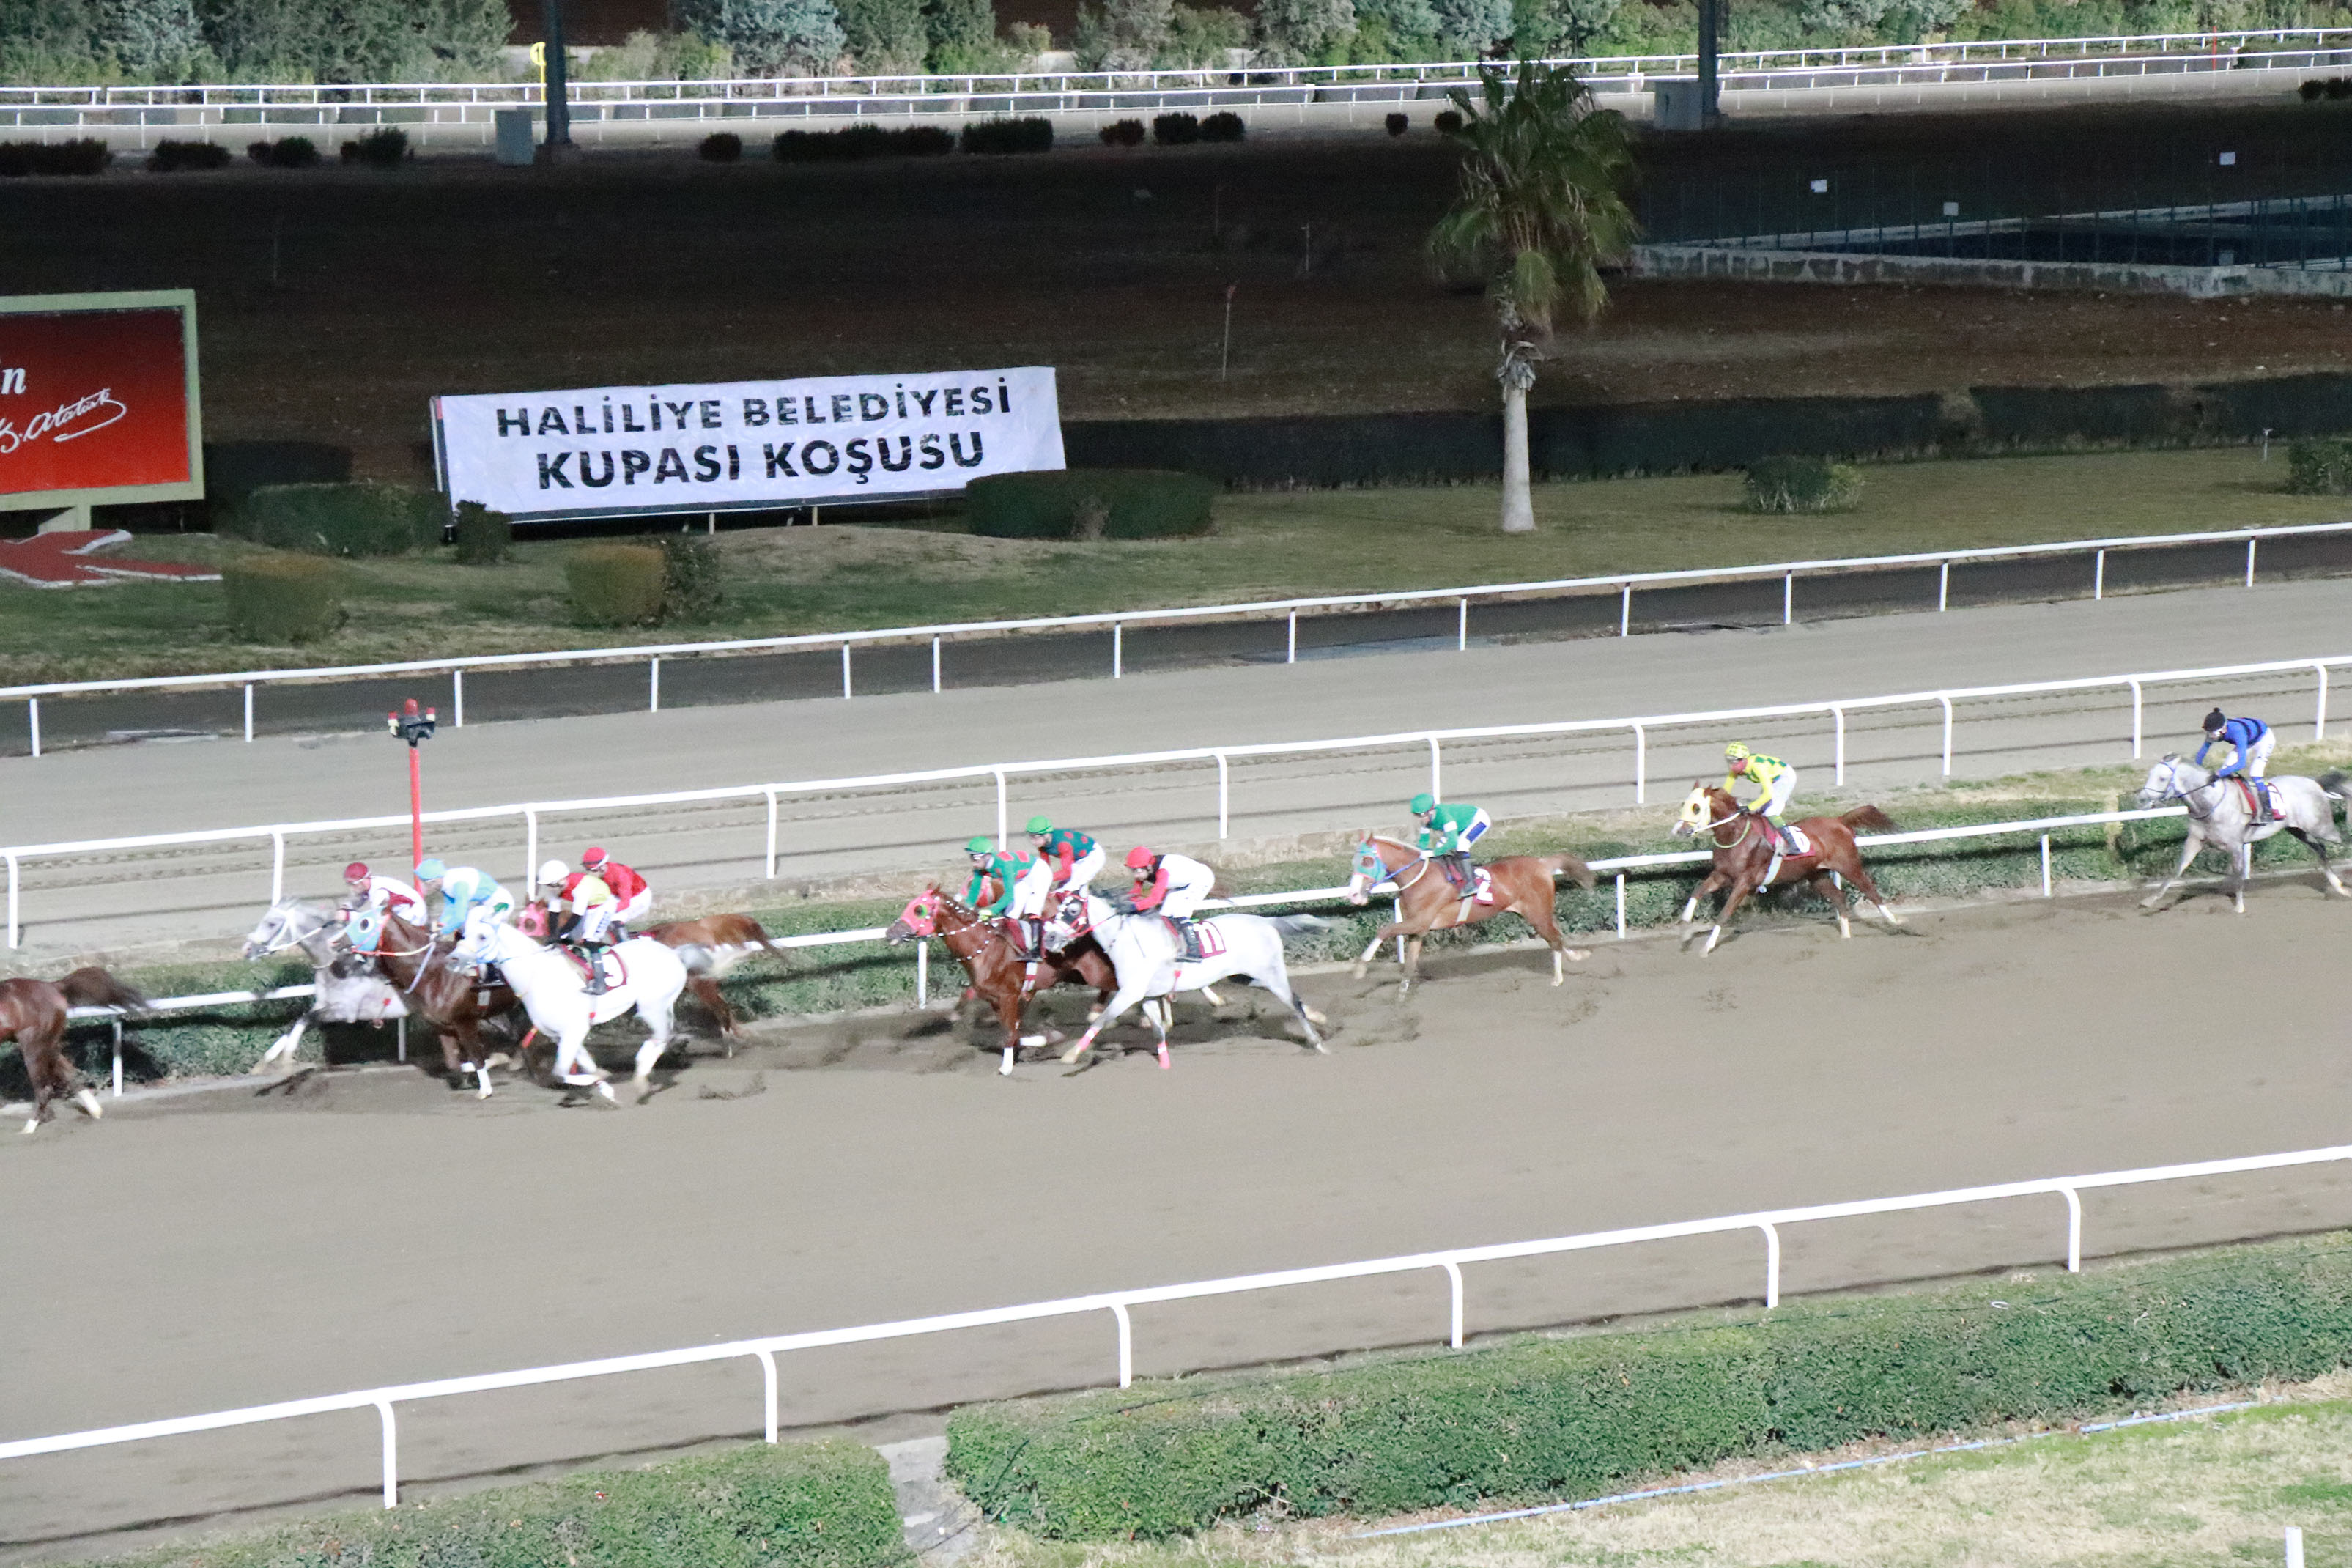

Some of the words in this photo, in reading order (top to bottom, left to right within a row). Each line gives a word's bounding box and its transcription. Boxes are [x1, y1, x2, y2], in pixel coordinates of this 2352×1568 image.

[497, 393, 722, 437] HALİLİYE
[742, 377, 1010, 426] BELEDİYESİ
[536, 445, 740, 489] KUPASI
[763, 432, 983, 484] KOŞUSU
[1786, 826, 1811, 853] 6
[1474, 868, 1493, 901] 2
[1193, 921, 1226, 953] 11
